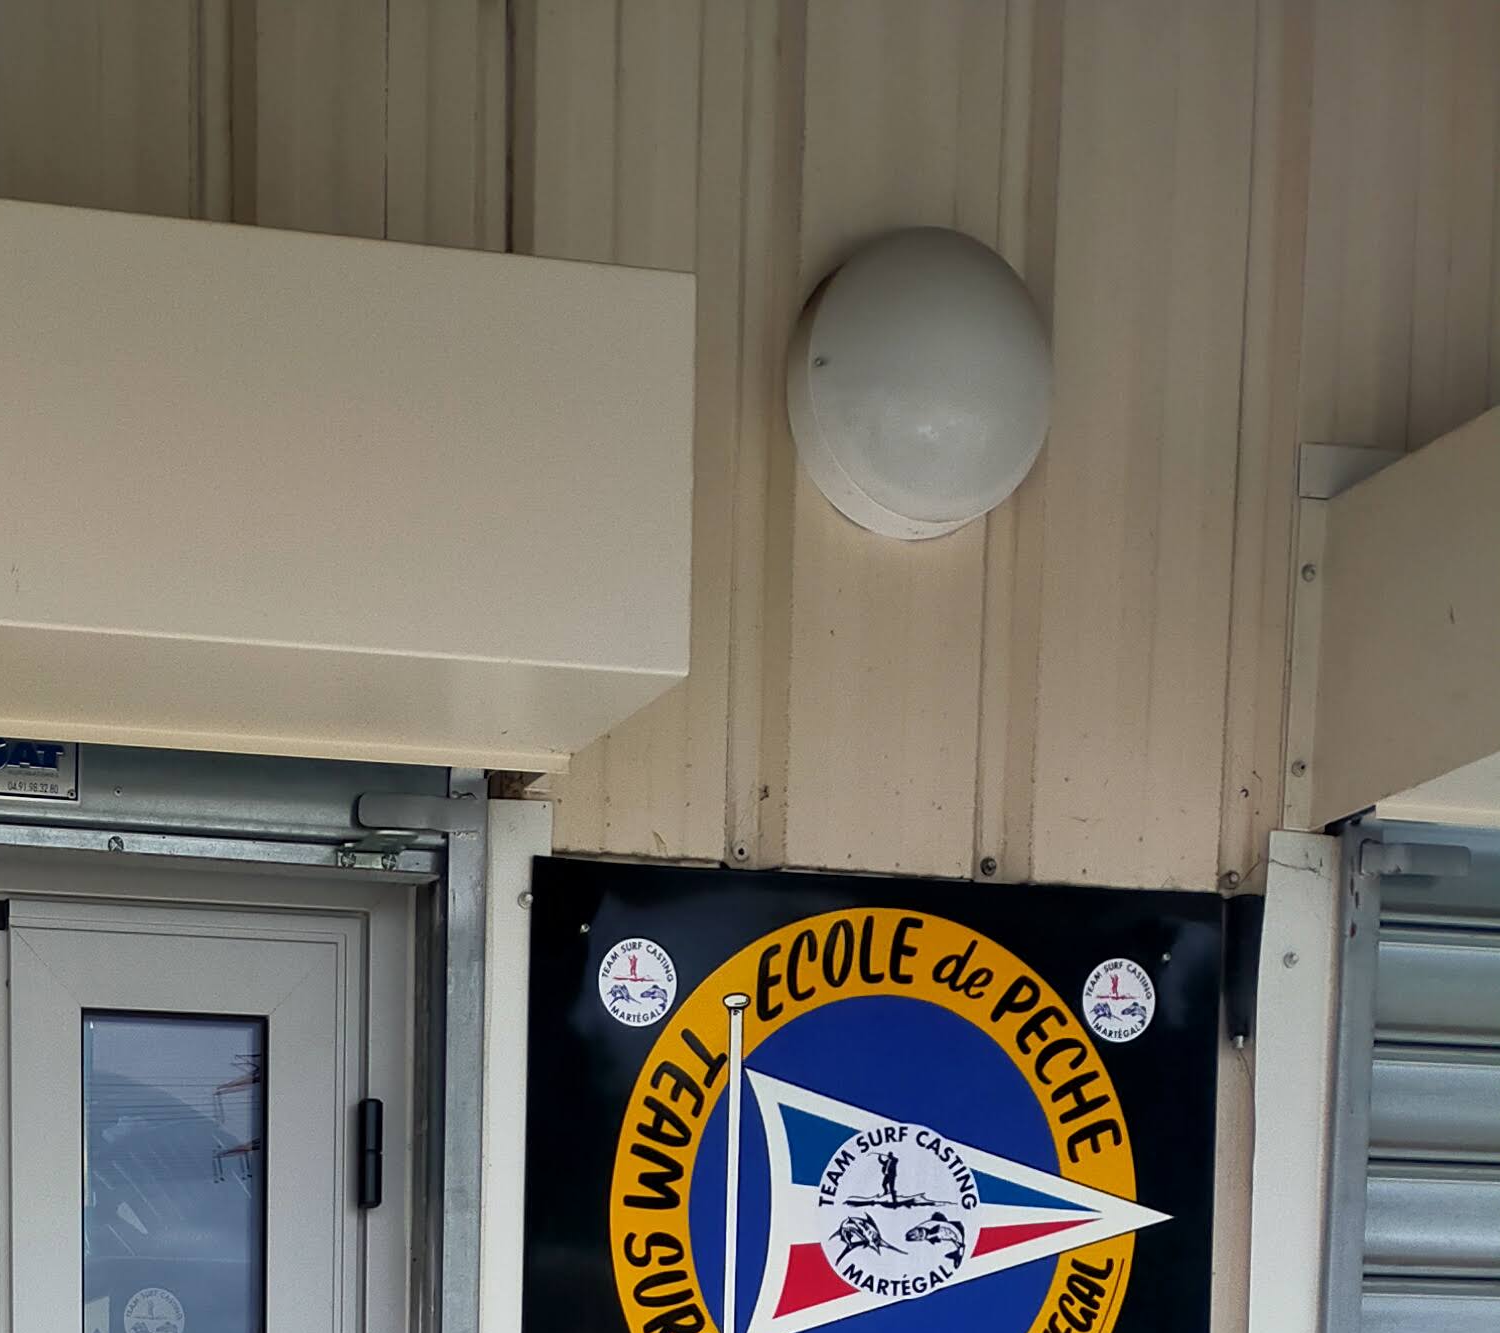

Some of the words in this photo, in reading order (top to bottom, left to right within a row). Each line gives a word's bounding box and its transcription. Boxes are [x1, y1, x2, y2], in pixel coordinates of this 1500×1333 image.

[601, 951, 620, 978] TEAM
[620, 942, 643, 954] SURF
[646, 944, 674, 982] CASTING
[1085, 971, 1102, 997] TEAM
[1103, 961, 1123, 973] SURF
[1126, 964, 1153, 1000] CASTING
[756, 915, 924, 1021] ECOLE
[932, 940, 994, 999] de
[990, 975, 1123, 1163] PECHE
[623, 1028, 727, 1210] TEAM
[818, 1150, 856, 1207] TEAM
[856, 1126, 908, 1153] SURF
[916, 1131, 978, 1210] CASTING
[842, 1263, 953, 1297] MARTÉGAL
